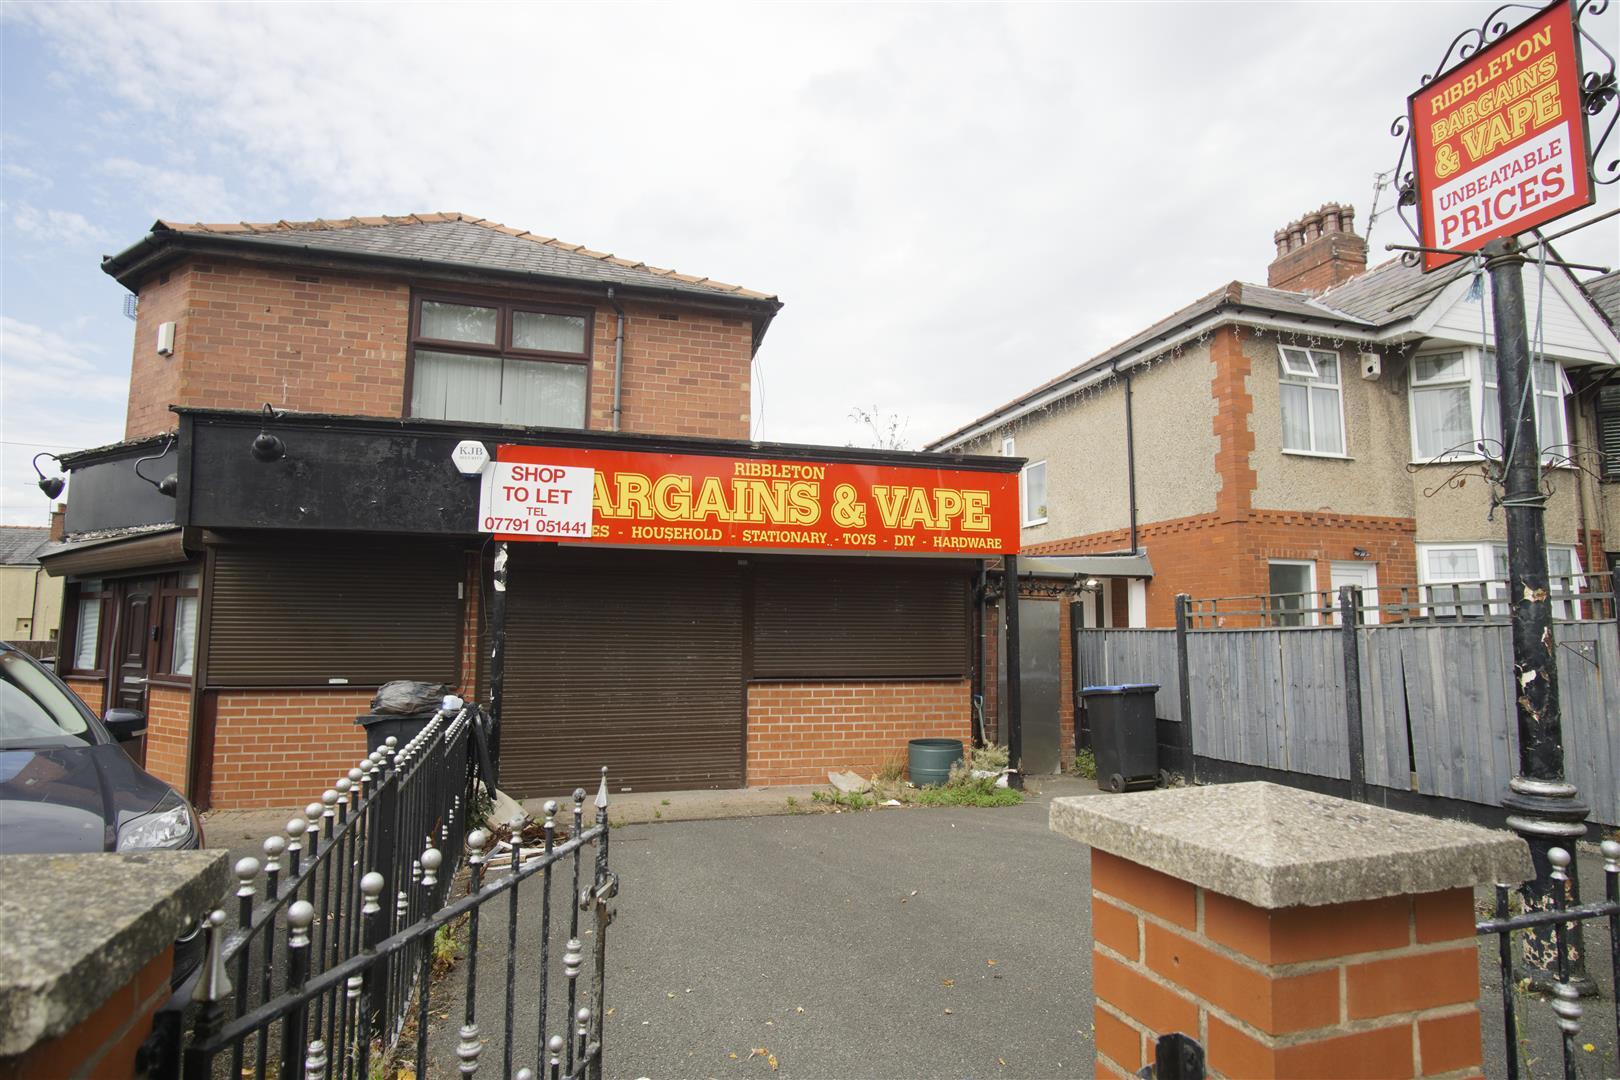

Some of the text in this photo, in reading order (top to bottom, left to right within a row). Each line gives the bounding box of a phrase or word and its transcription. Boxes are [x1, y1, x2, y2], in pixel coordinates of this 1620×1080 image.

[1431, 25, 1552, 116] RIBBLETON
[1431, 51, 1558, 147] BARGAINS
[1434, 80, 1563, 180] & VAPE
[1439, 138, 1563, 212] UNBEATABLE
[1441, 164, 1566, 246] PRICES
[459, 446, 483, 456] KJB
[511, 466, 566, 483] SHOP
[734, 462, 825, 480] RIBBLETON
[503, 486, 573, 504] TO LET
[592, 471, 992, 532] ARGAINS & VAPE
[526, 506, 548, 517] TEL
[484, 516, 587, 535] 07791 051441
[632, 526, 723, 541] HOUSEHOLD
[742, 529, 828, 545] STATIONARY
[842, 533, 877, 546] TOYS
[894, 535, 916, 547] DIY
[933, 536, 1002, 549] HARDWARE
